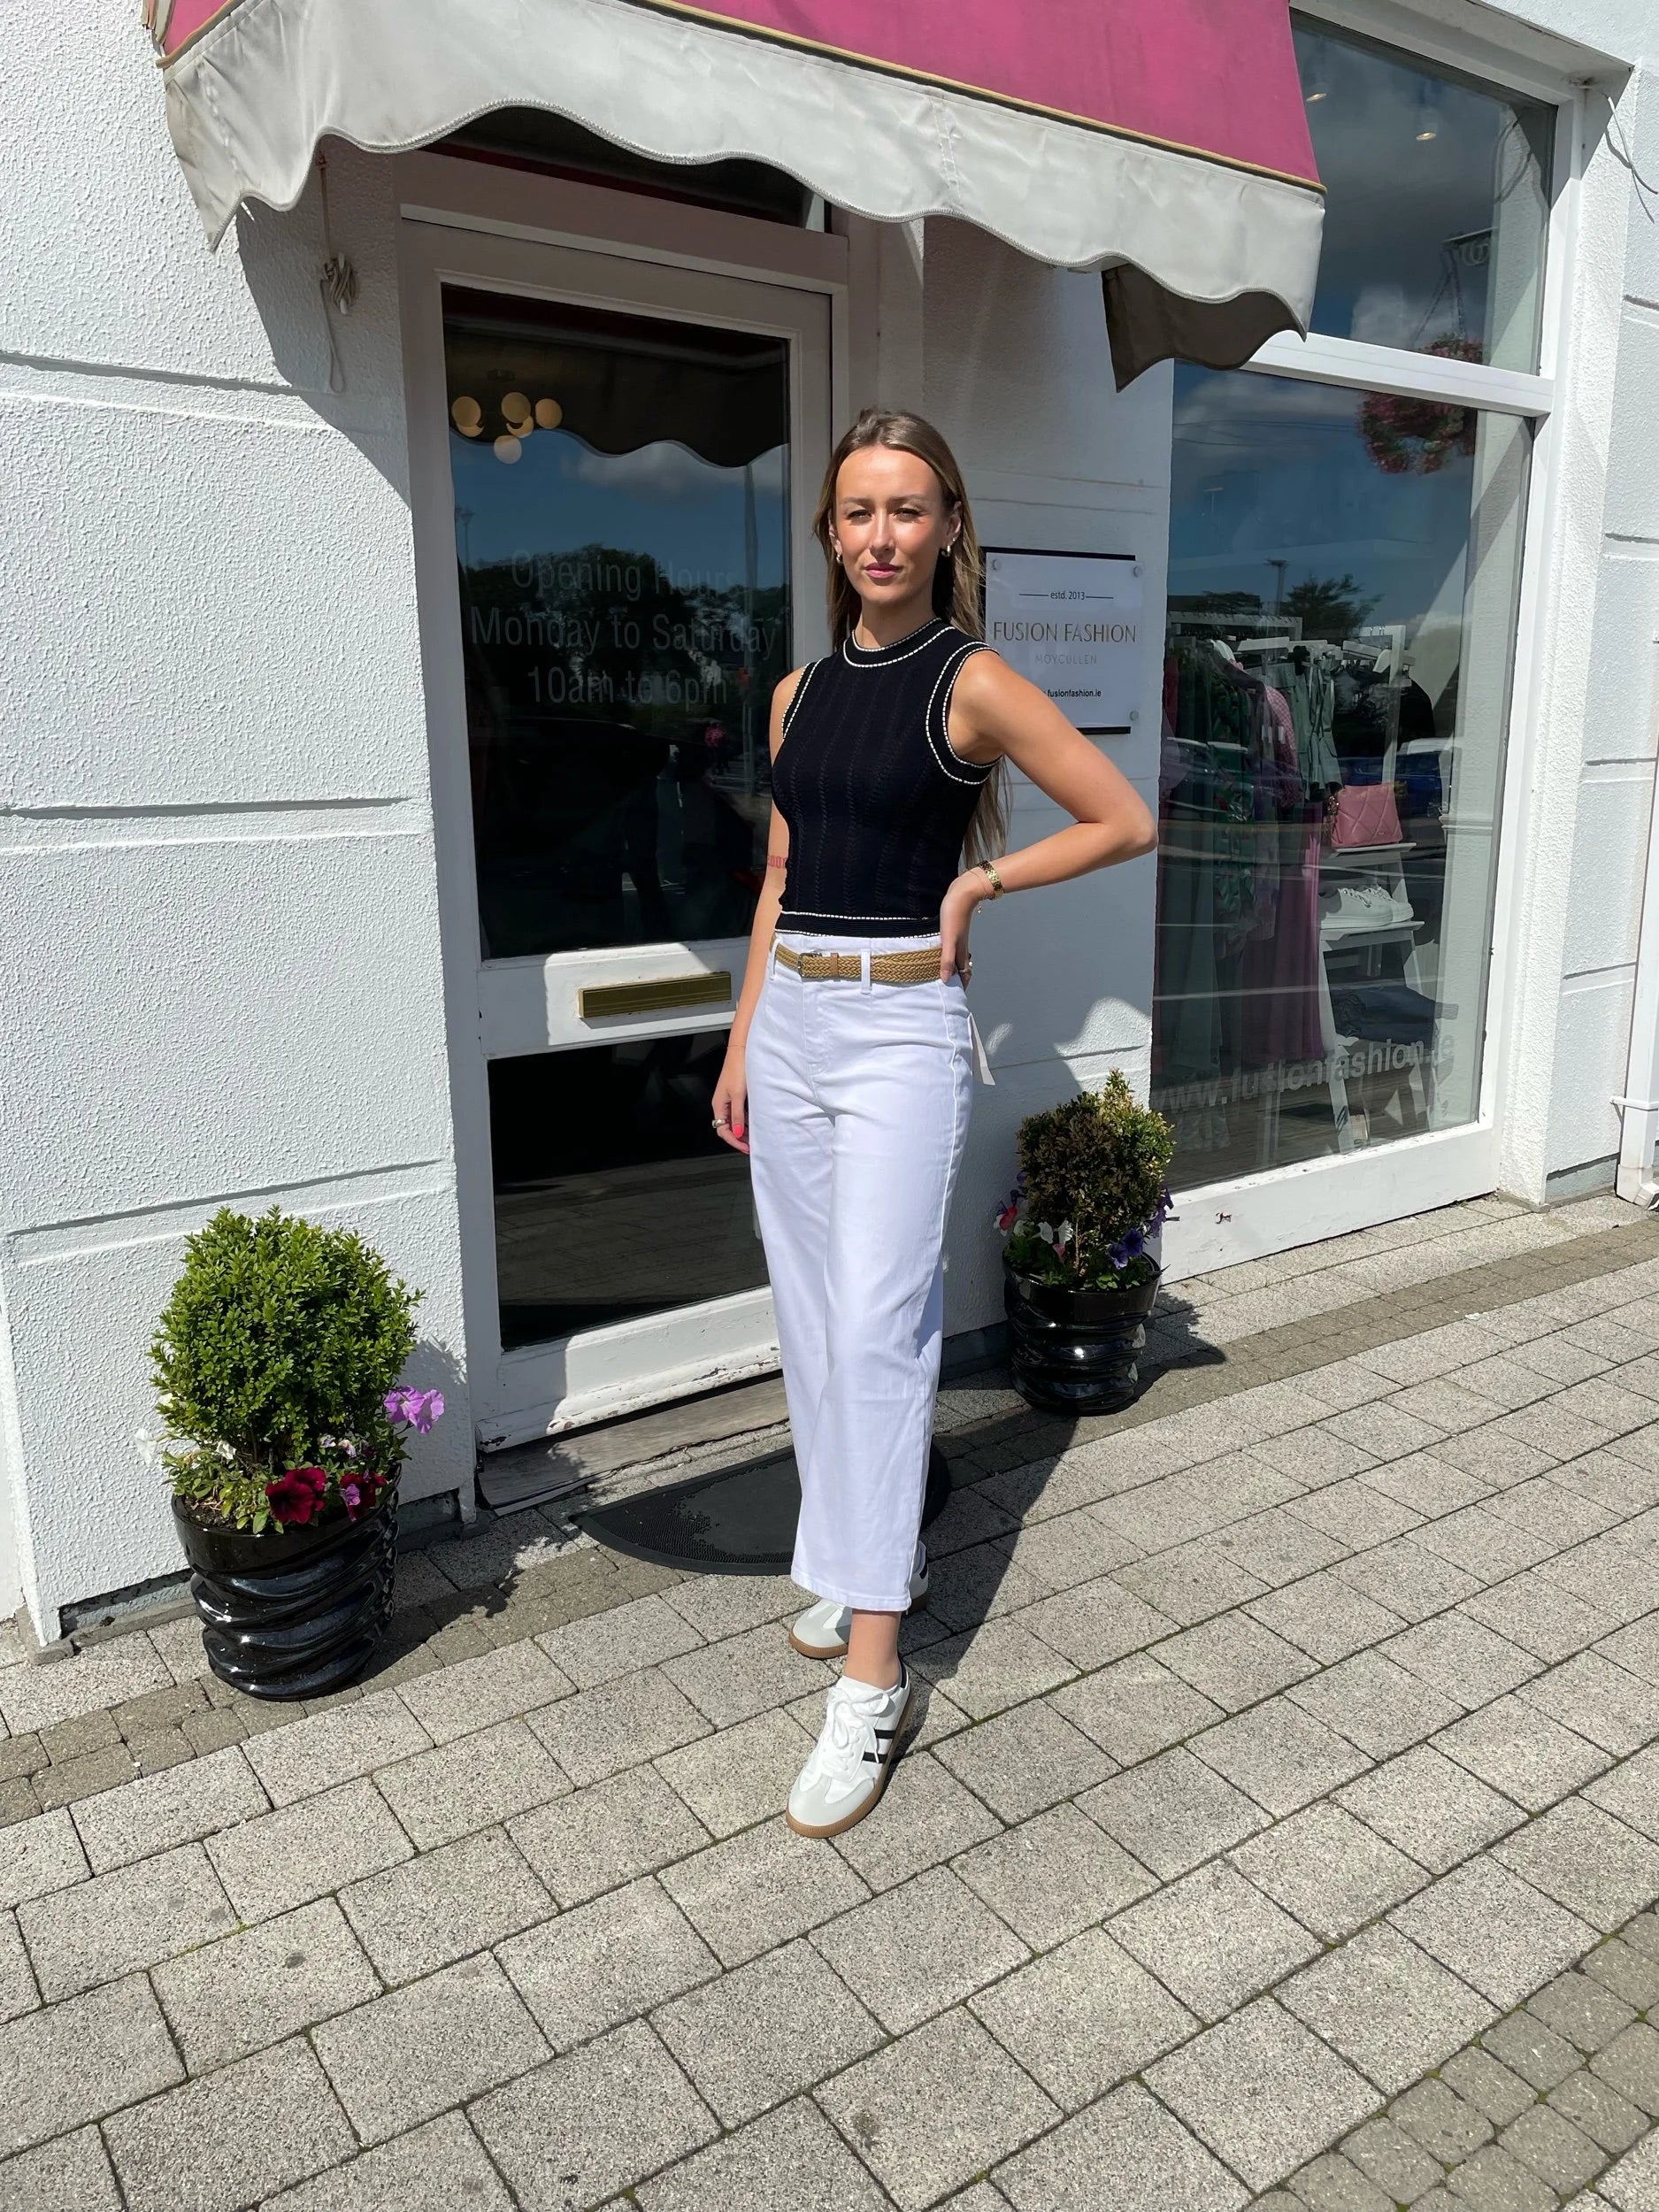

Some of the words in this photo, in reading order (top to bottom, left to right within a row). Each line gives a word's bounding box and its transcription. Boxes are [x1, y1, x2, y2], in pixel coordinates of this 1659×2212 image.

[511, 549, 641, 602] Opening
[655, 560, 738, 597] Hours
[1050, 591, 1067, 600] estd.
[1068, 591, 1086, 601] 2013
[471, 605, 601, 656] Monday
[611, 615, 641, 649] to
[653, 613, 776, 660] Saturday
[994, 622, 1057, 641] FUSION
[1064, 623, 1136, 642] FASHION
[1035, 654, 1097, 665] MOYCULLEN
[528, 665, 615, 704] 10am
[627, 668, 654, 705] to
[665, 669, 727, 711] 6pm
[1044, 689, 1102, 698] fusionfashion.ie
